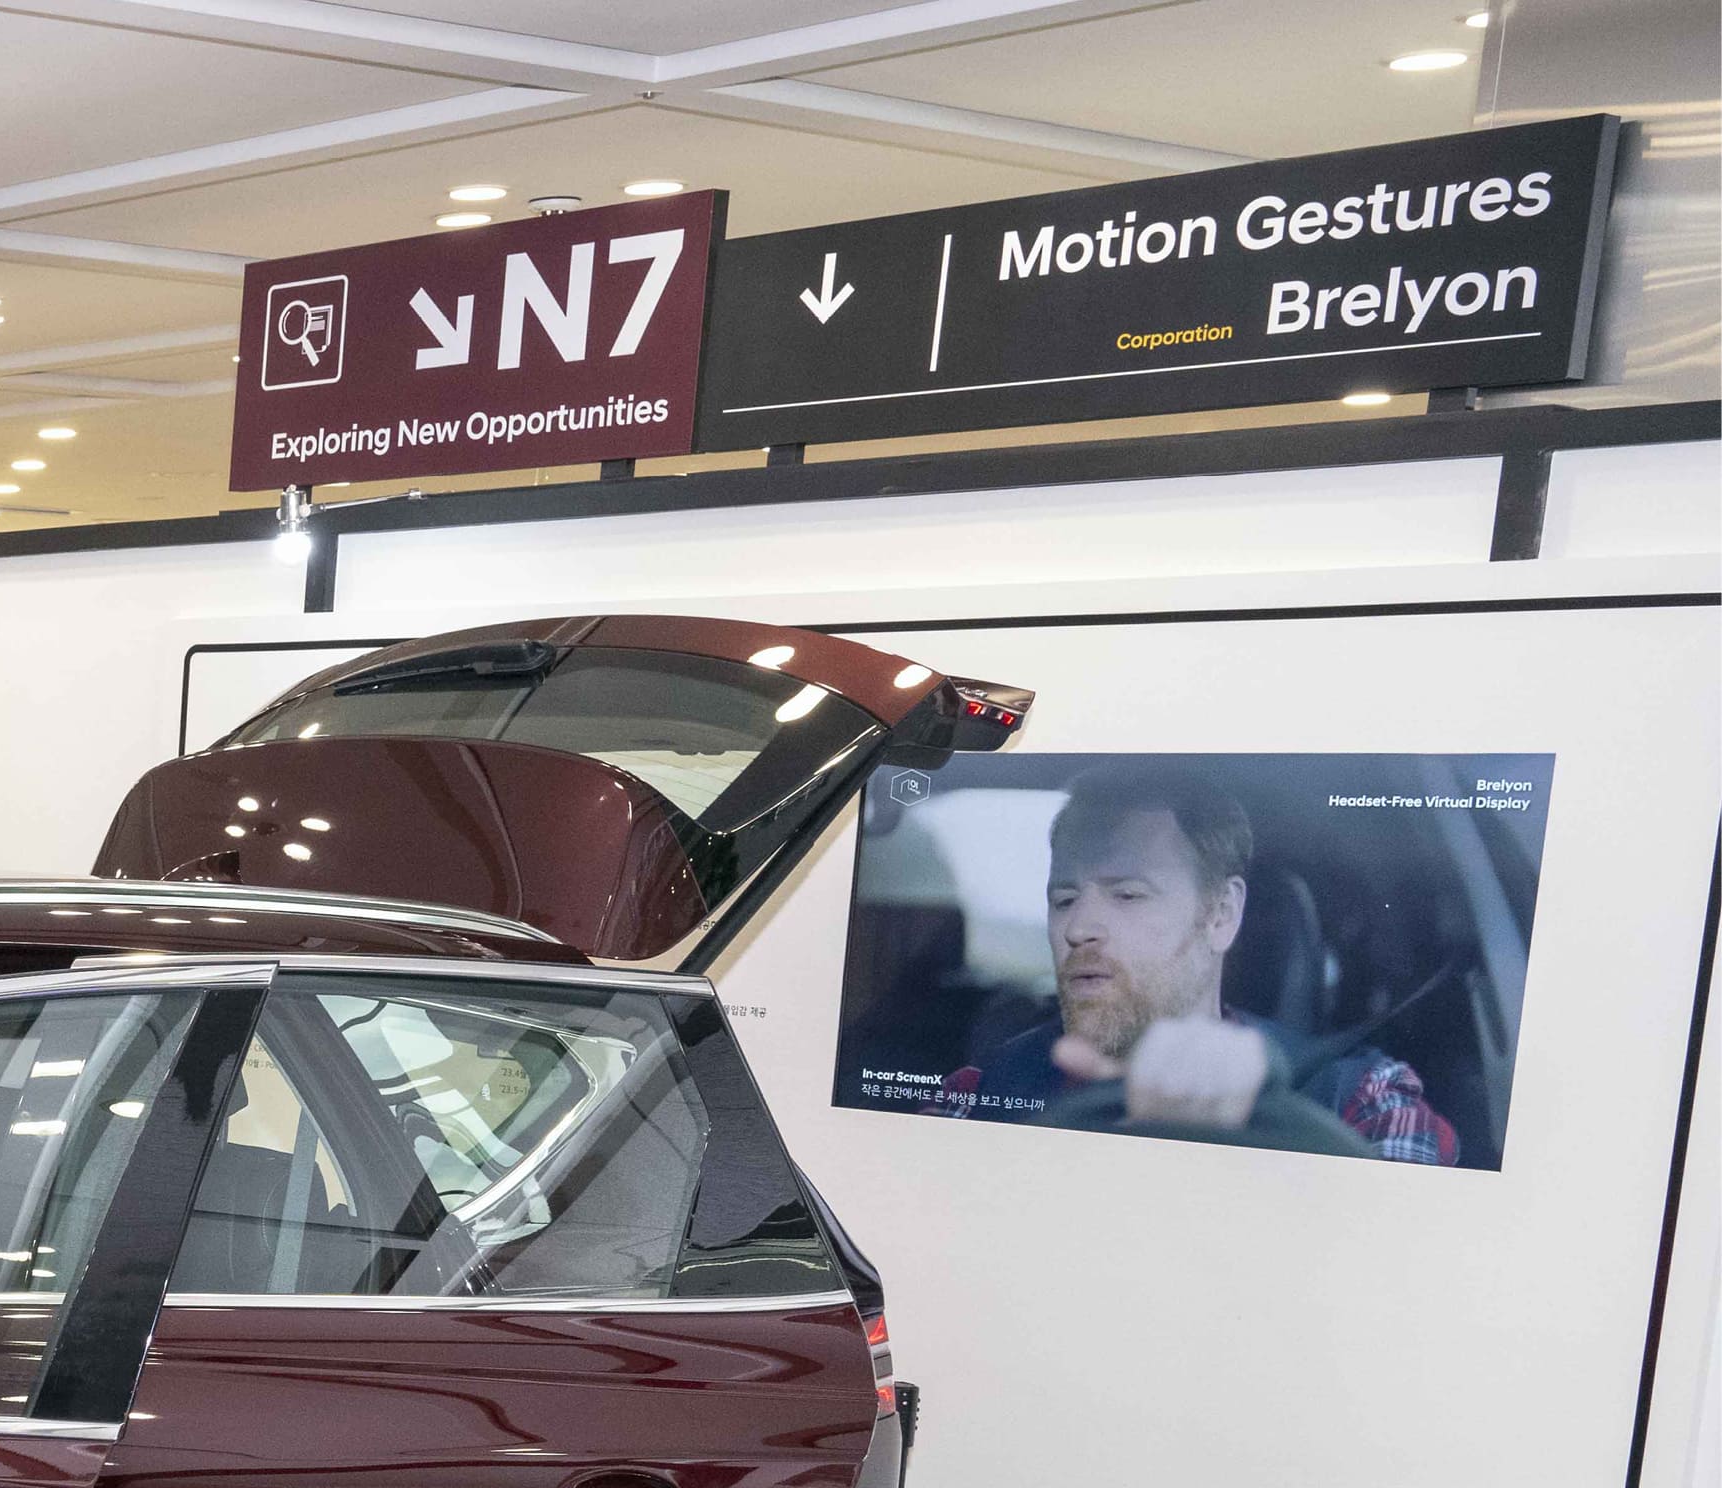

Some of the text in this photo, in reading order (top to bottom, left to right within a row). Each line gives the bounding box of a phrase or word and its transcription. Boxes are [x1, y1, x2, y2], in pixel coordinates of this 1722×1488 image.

[998, 171, 1552, 281] Motion Gestures
[497, 228, 685, 370] N7
[1266, 265, 1537, 334] Brelyon
[1116, 323, 1233, 350] Corporation
[271, 394, 669, 462] Exploring New Opportunities
[1476, 779, 1532, 793] Brelyon
[1328, 795, 1531, 811] Headset-Free Virtual Display
[862, 1068, 942, 1085] In-car ScreenX
[861, 1083, 1045, 1112] 작은 공간에서도 큰 세상을 보고 싶으니까
